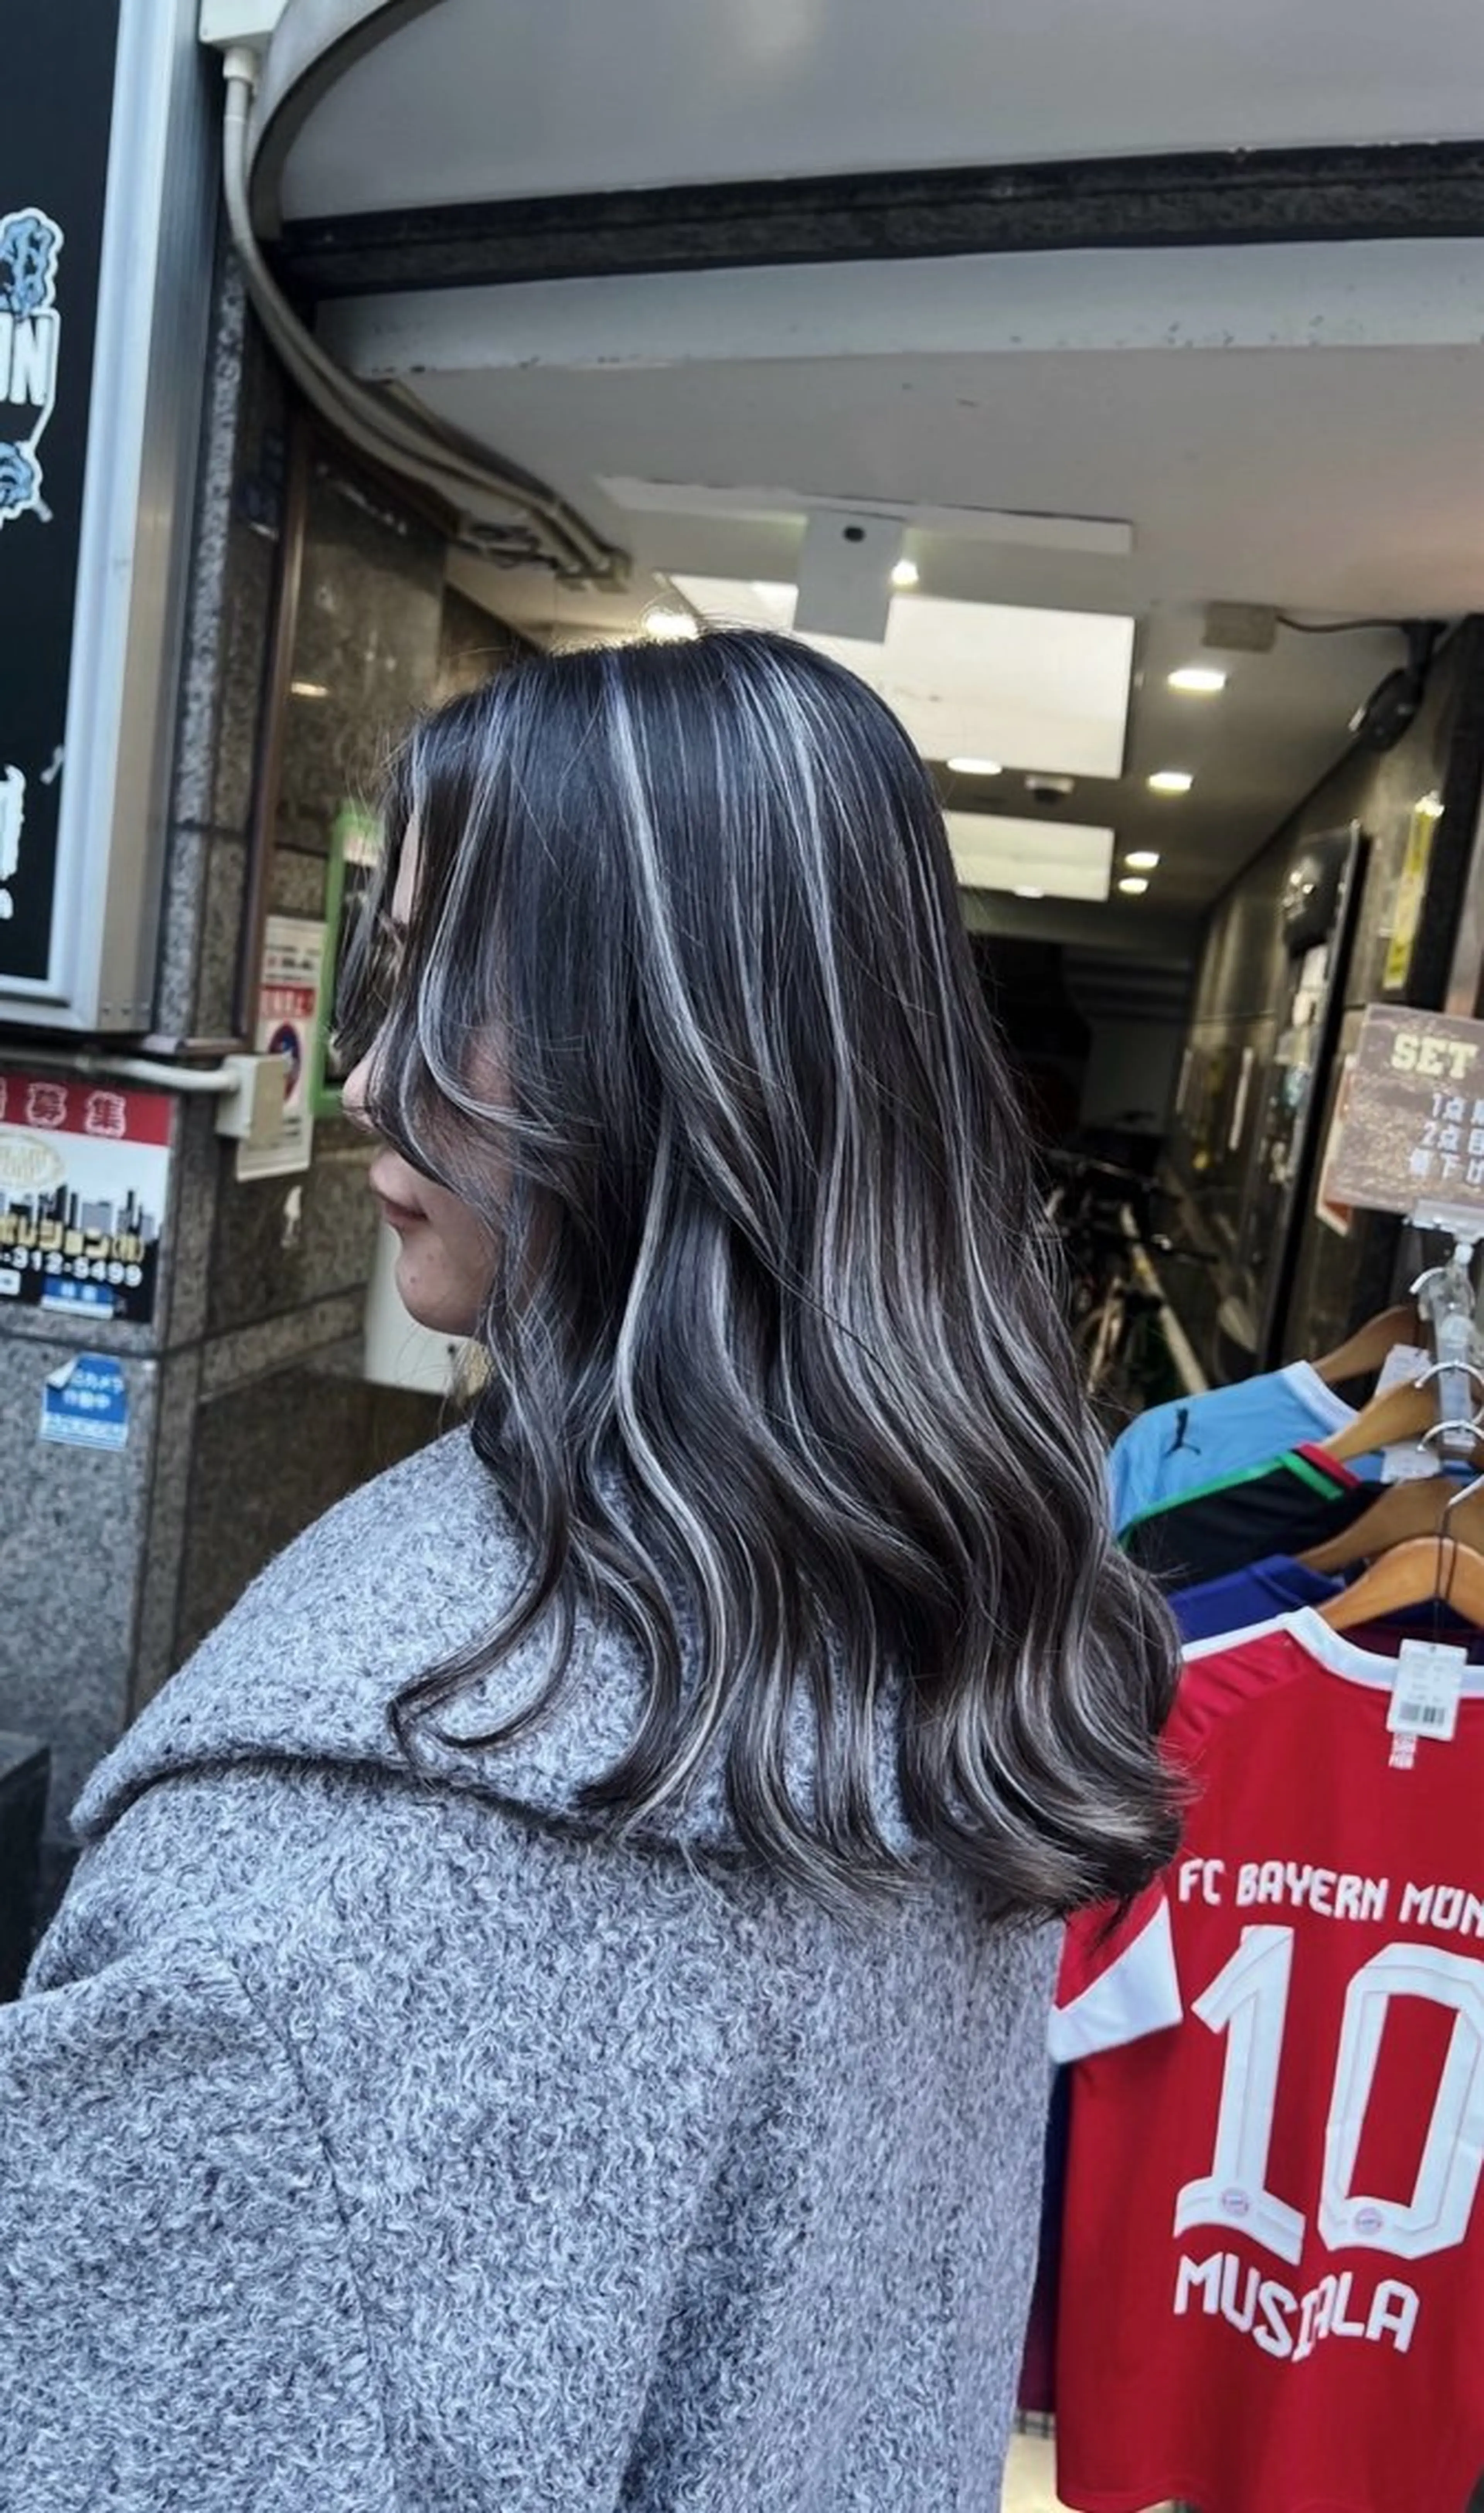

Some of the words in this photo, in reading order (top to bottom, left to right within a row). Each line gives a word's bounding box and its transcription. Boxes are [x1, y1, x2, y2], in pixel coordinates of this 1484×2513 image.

[1392, 1033, 1478, 1079] SET
[1179, 1858, 1225, 1905] FC
[1236, 1860, 1389, 1922] BAYERN
[1173, 1924, 1484, 2266] 10
